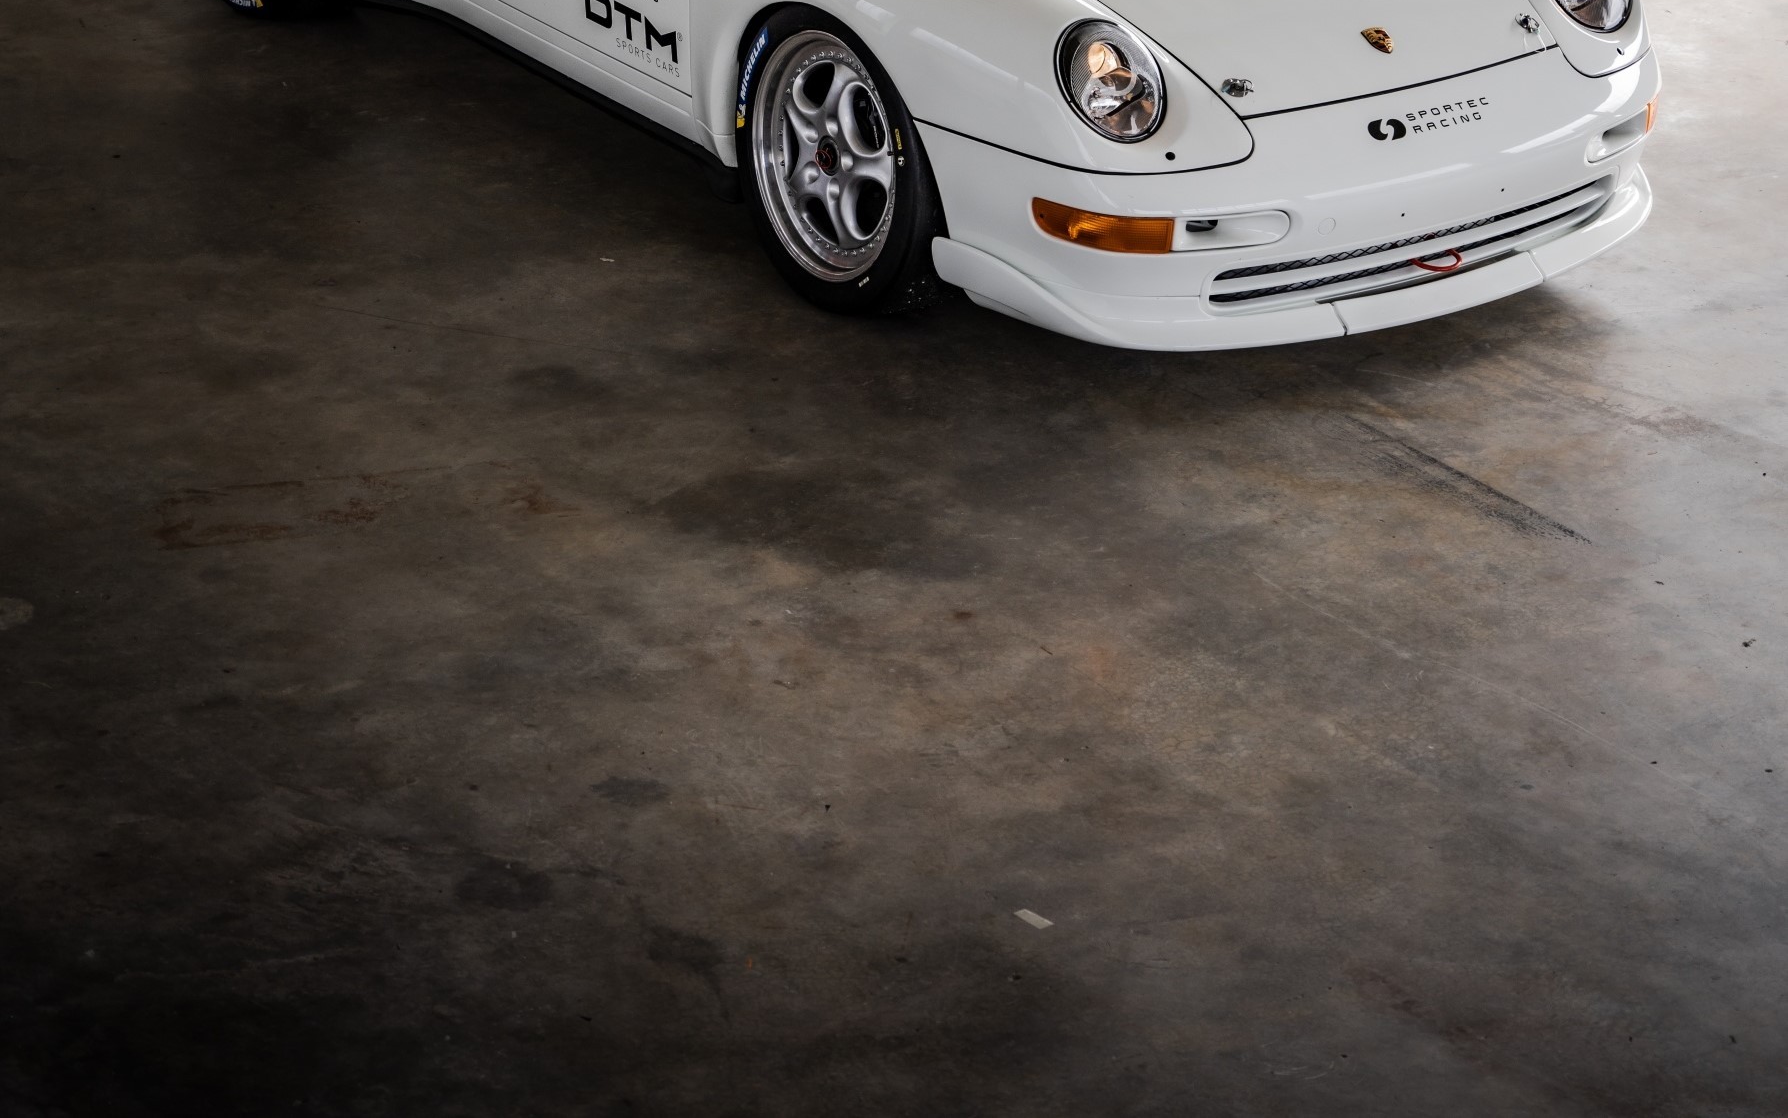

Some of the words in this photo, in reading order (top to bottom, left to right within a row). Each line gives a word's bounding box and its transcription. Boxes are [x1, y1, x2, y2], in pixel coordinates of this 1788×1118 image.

[615, 37, 652, 64] SPORTS
[655, 57, 680, 78] CARS
[739, 33, 766, 101] MICHELIN
[1405, 96, 1489, 122] SPORTEC
[1412, 111, 1482, 134] RACING
